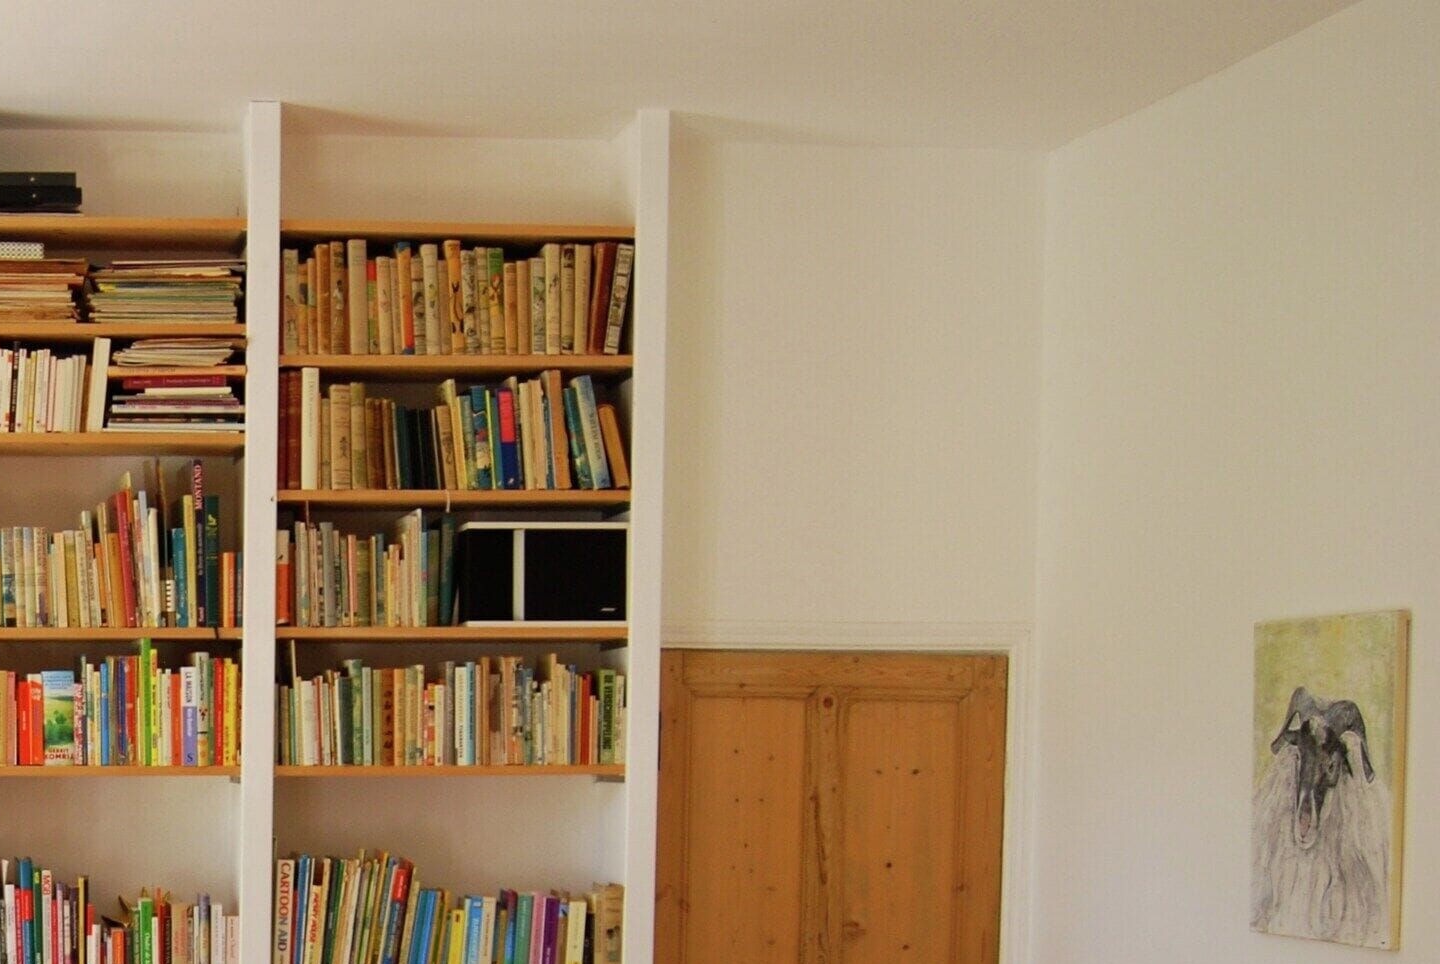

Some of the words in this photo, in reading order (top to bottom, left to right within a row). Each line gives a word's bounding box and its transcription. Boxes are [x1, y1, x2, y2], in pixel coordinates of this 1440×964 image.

[194, 465, 203, 510] MONTAND
[186, 671, 193, 679] LA
[185, 681, 193, 703] MAISON
[42, 874, 51, 895] MGB
[279, 862, 291, 925] CARTOON
[277, 929, 288, 951] AID
